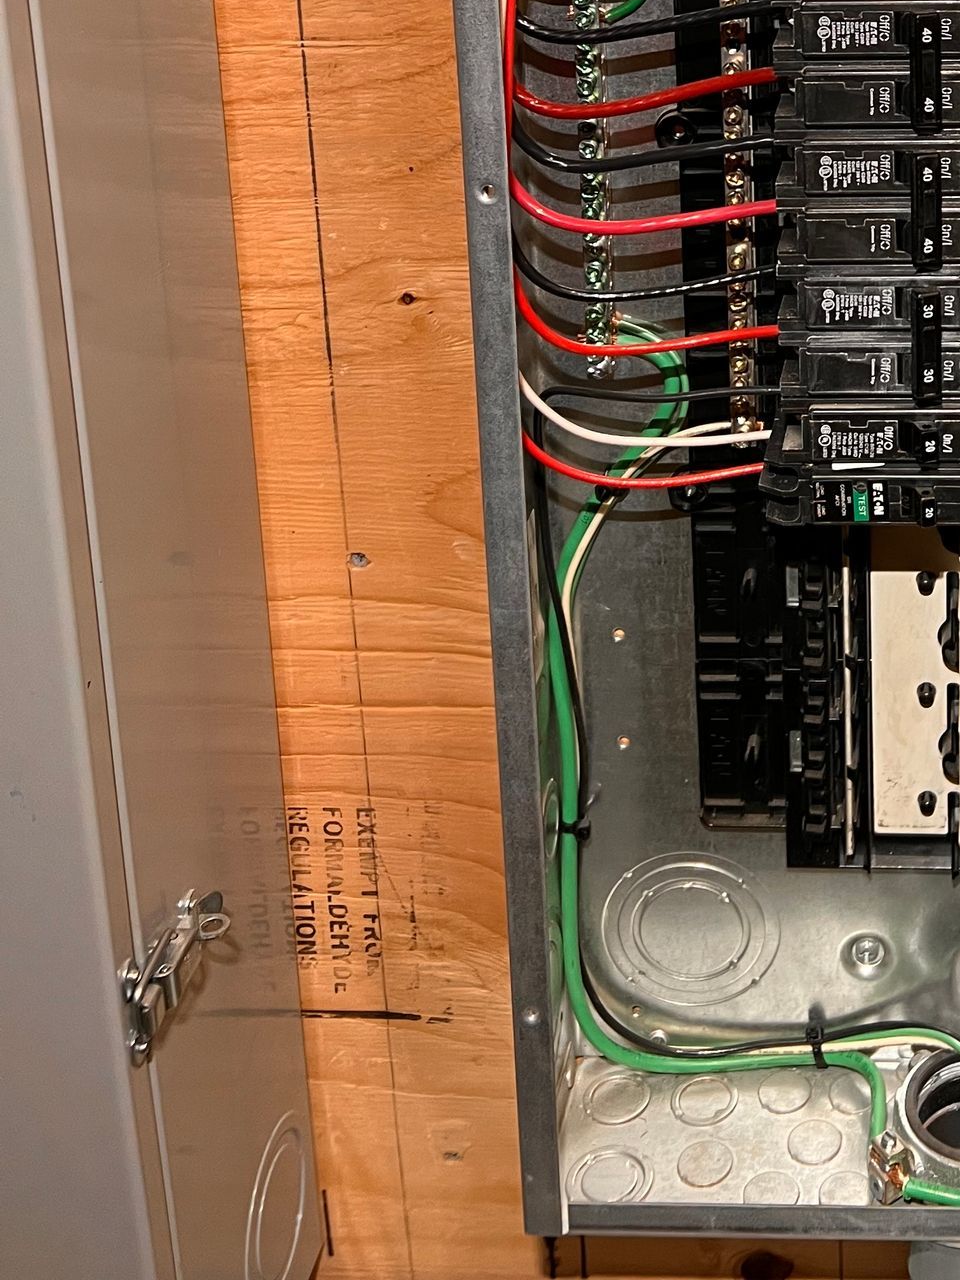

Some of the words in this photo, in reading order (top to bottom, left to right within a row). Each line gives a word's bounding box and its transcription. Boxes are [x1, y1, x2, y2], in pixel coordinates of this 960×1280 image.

[922, 27, 933, 43] 40
[924, 97, 934, 112] 40
[922, 167, 933, 182] 40
[923, 238, 934, 254] 40
[923, 304, 934, 319] 30
[924, 369, 934, 383] 30
[925, 440, 935, 453] 20
[858, 495, 866, 516] TEST
[873, 483, 884, 516] EATON
[925, 507, 933, 518] 20
[287, 807, 319, 970] REGULATIONS
[322, 807, 352, 994] FORMALDEHYDE
